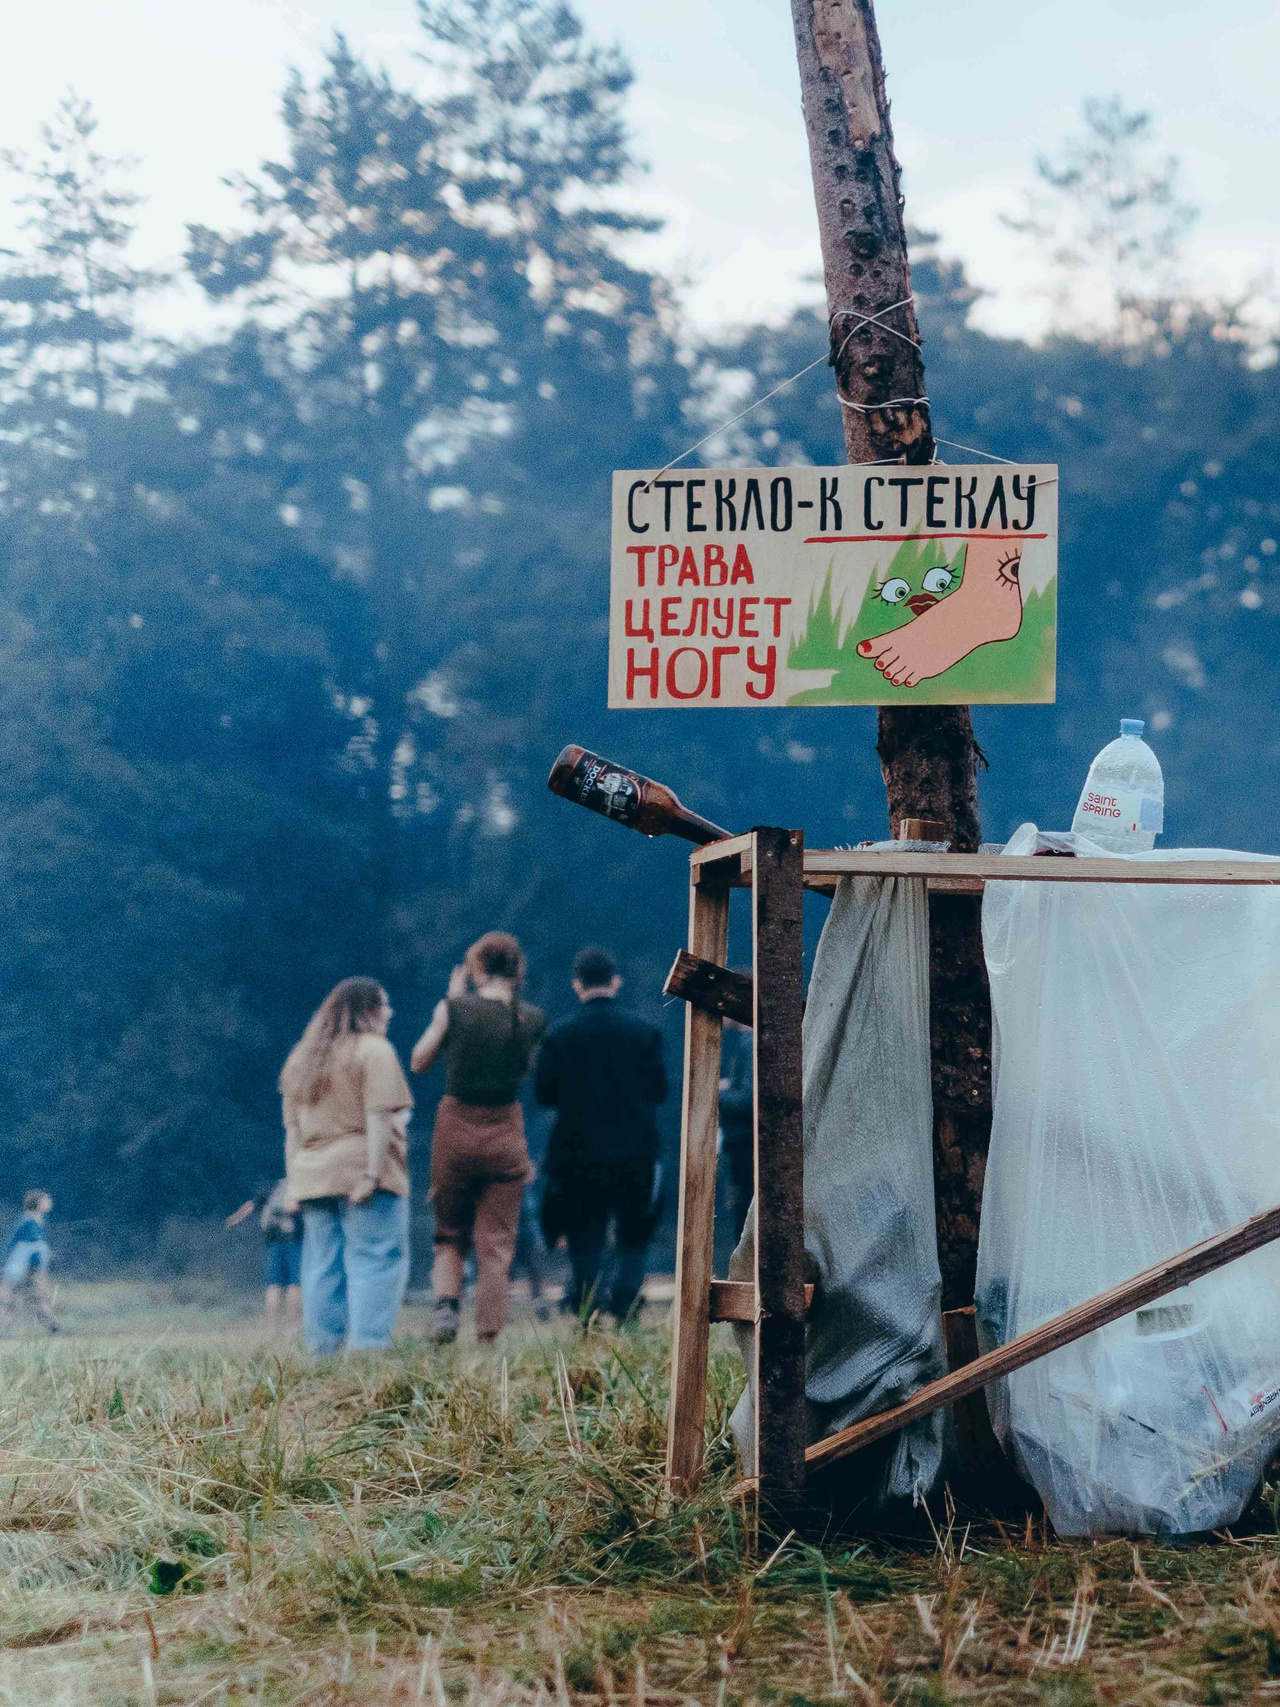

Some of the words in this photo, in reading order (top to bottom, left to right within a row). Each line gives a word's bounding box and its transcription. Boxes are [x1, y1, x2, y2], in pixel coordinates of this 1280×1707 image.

[863, 475, 1037, 531] СТЕКЛУ
[626, 544, 755, 587] ТРАВА
[625, 597, 792, 643] ЦЕЛУЕТ
[626, 645, 777, 700] НОГУ
[581, 765, 601, 801] DOCKE
